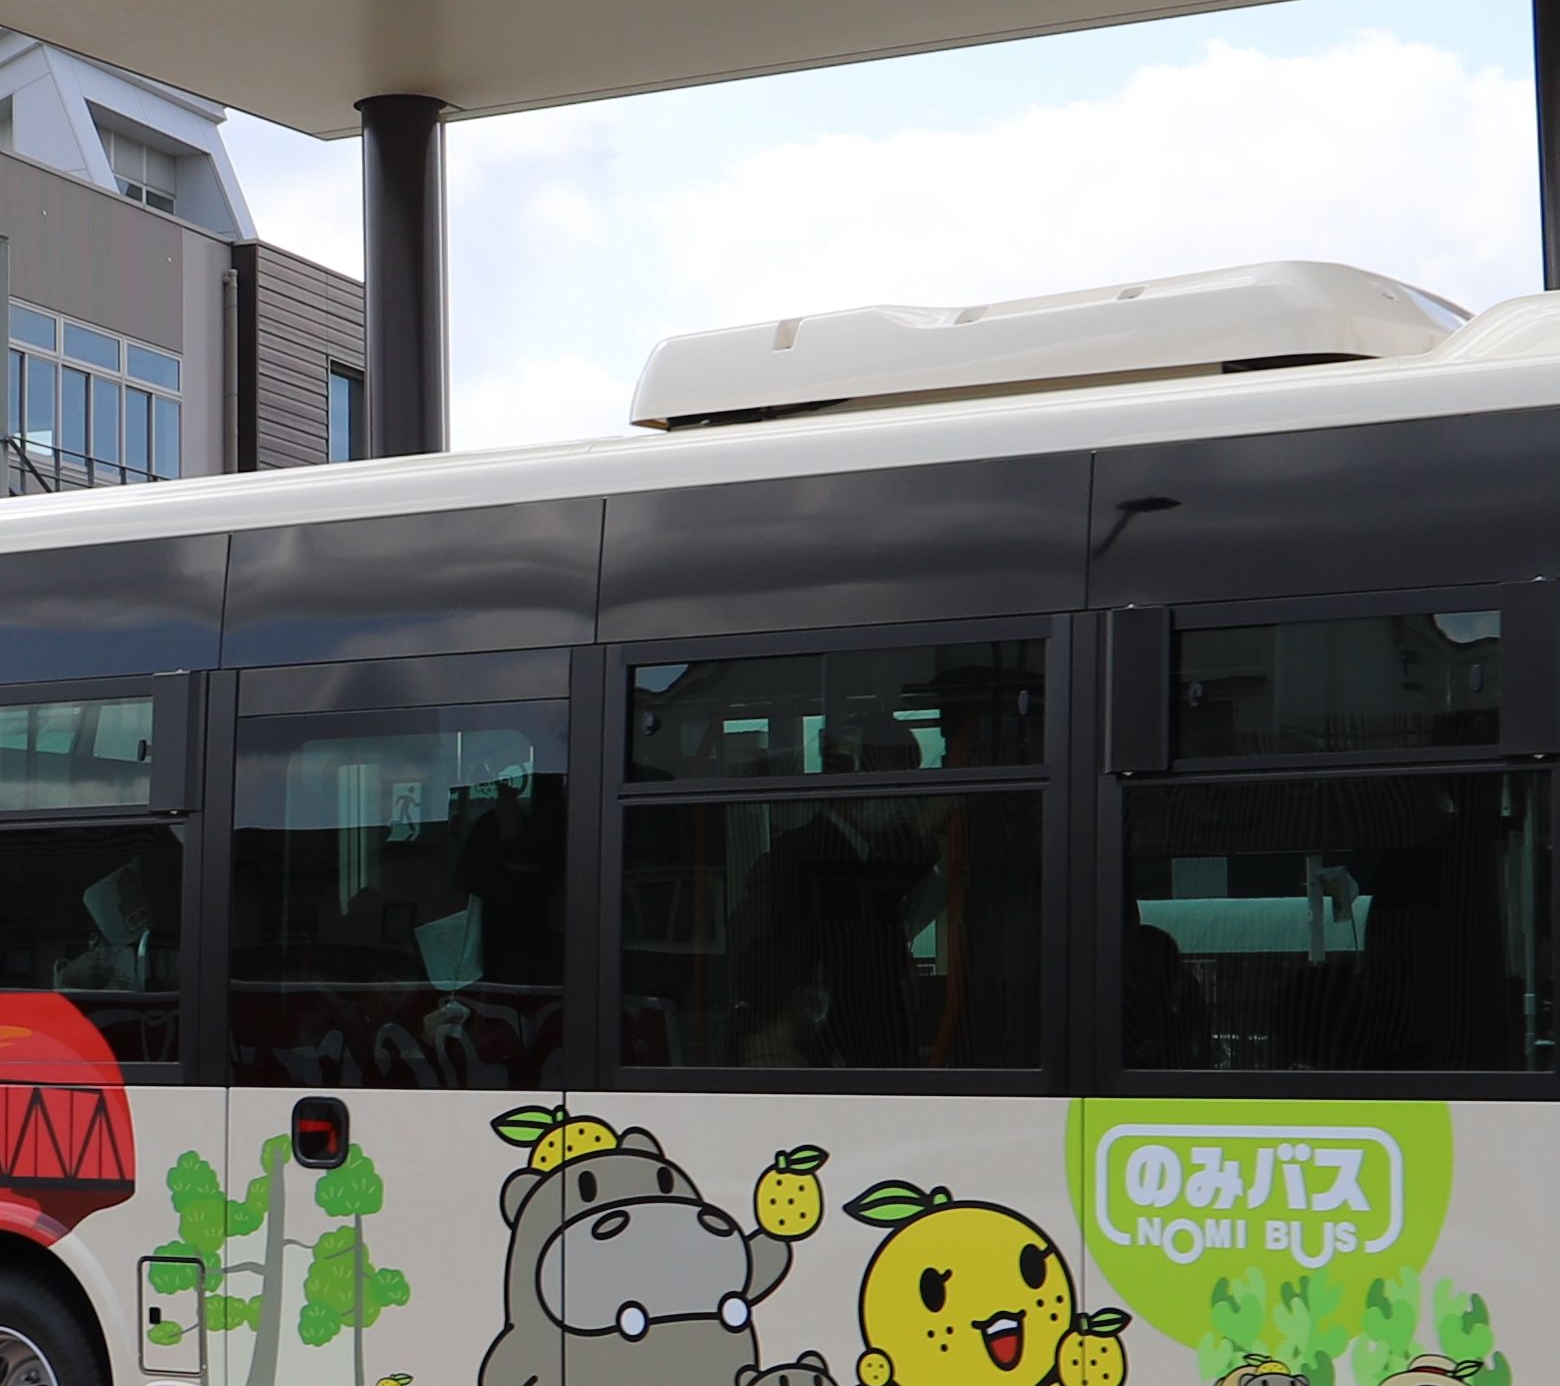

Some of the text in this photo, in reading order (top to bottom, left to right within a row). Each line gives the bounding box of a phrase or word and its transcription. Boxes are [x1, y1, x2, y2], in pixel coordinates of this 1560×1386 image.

[1125, 1143, 1371, 1211] のみバス
[1137, 1217, 1358, 1269] NOMI BUS
